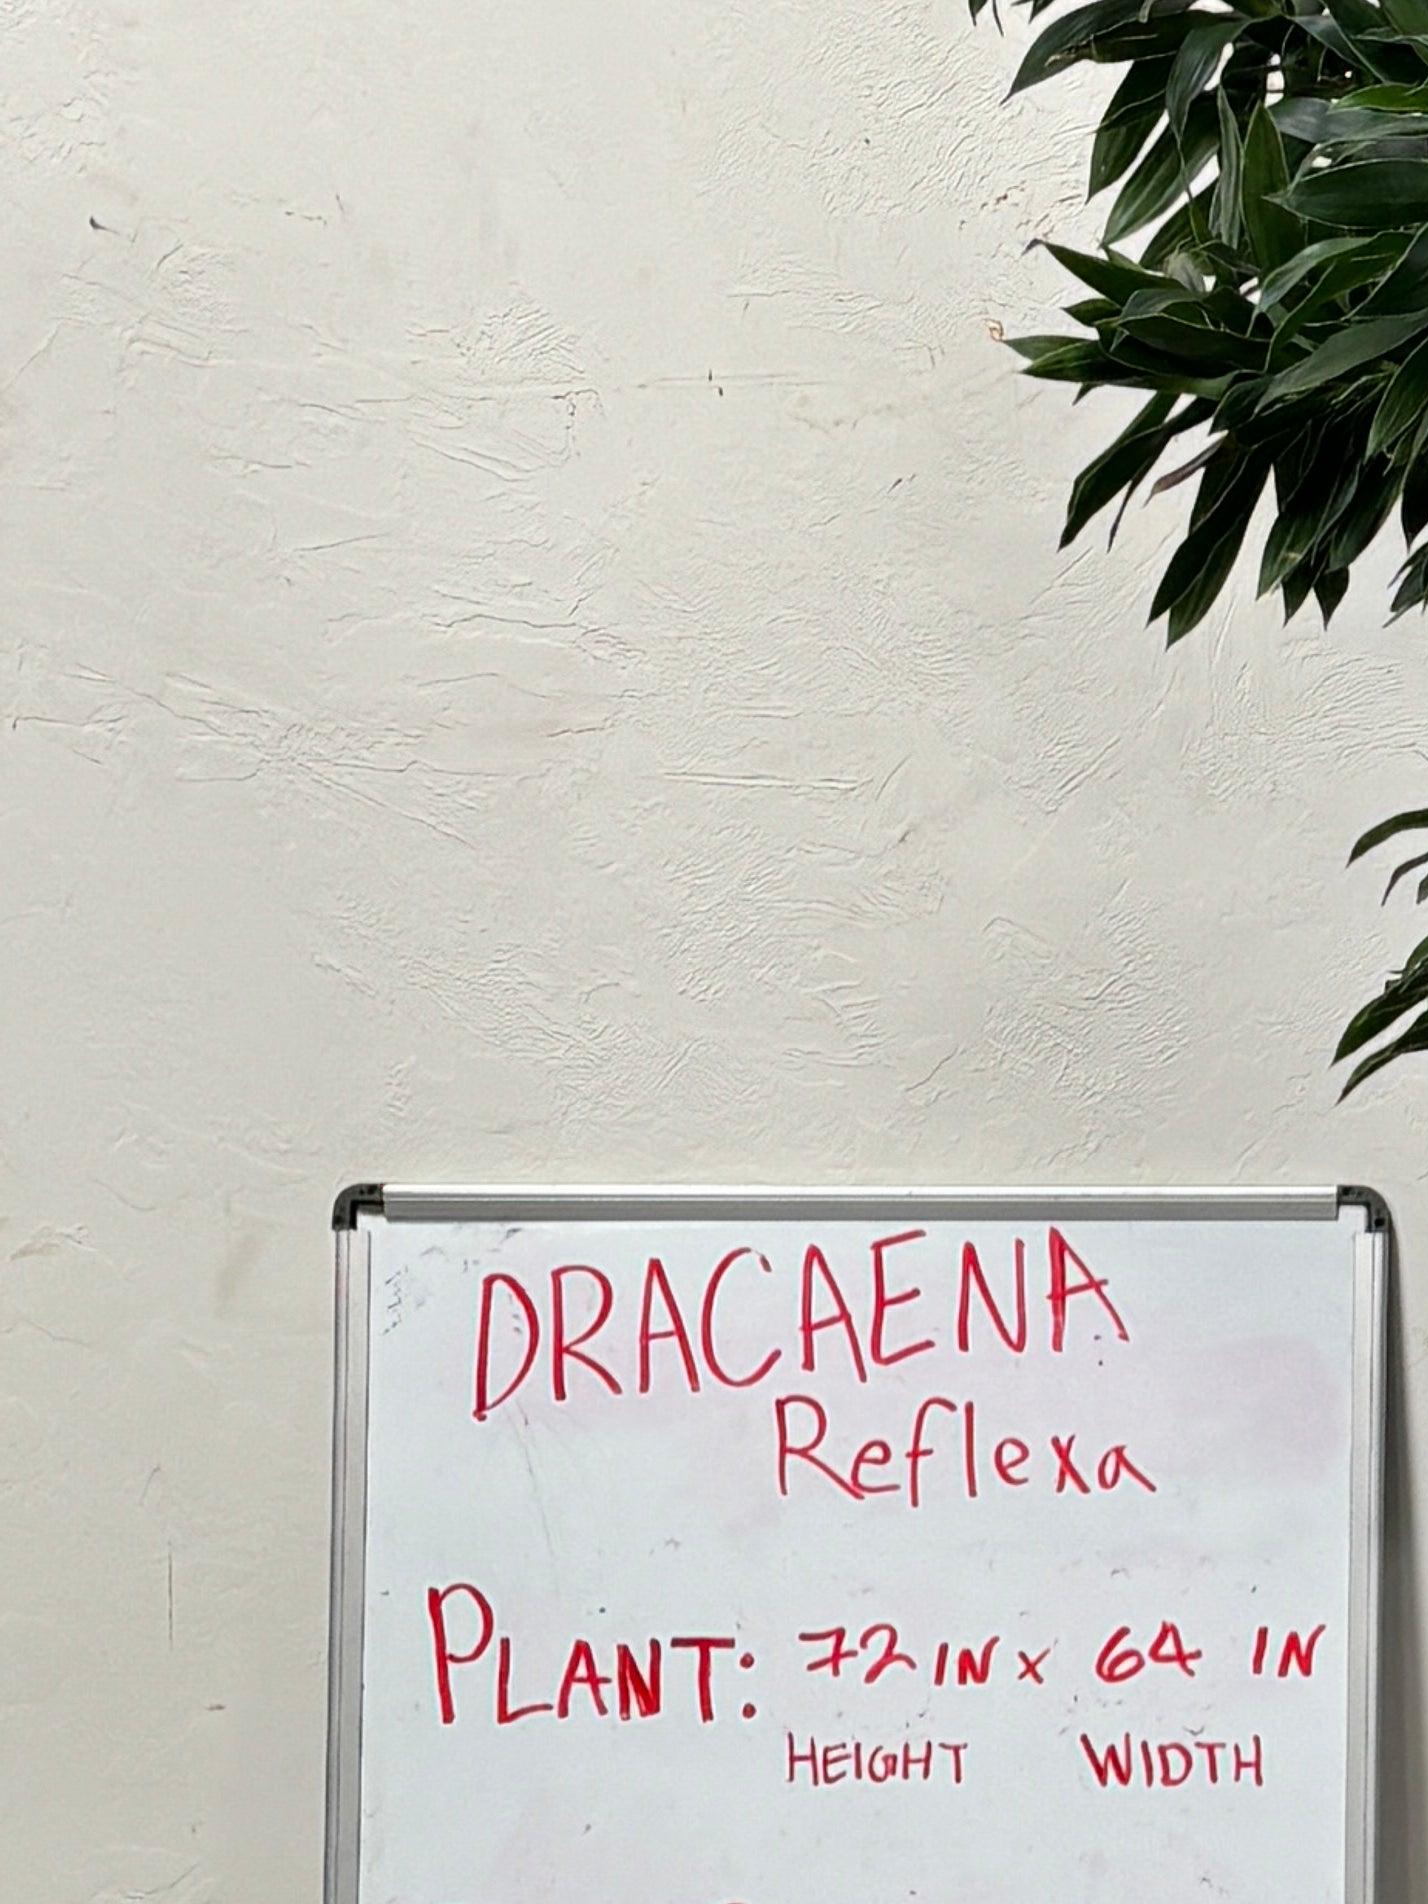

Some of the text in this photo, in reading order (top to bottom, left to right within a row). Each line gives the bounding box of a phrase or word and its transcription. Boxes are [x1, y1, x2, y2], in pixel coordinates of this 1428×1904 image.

[472, 1226, 1130, 1422] DRACAENA
[774, 1395, 1153, 1507] Reflexa
[427, 1585, 754, 1725] PLANT:
[1095, 1623, 1200, 1684] 64
[1252, 1627, 1323, 1678] IN
[786, 1733, 1263, 1787] HEIGHT WIDTH
